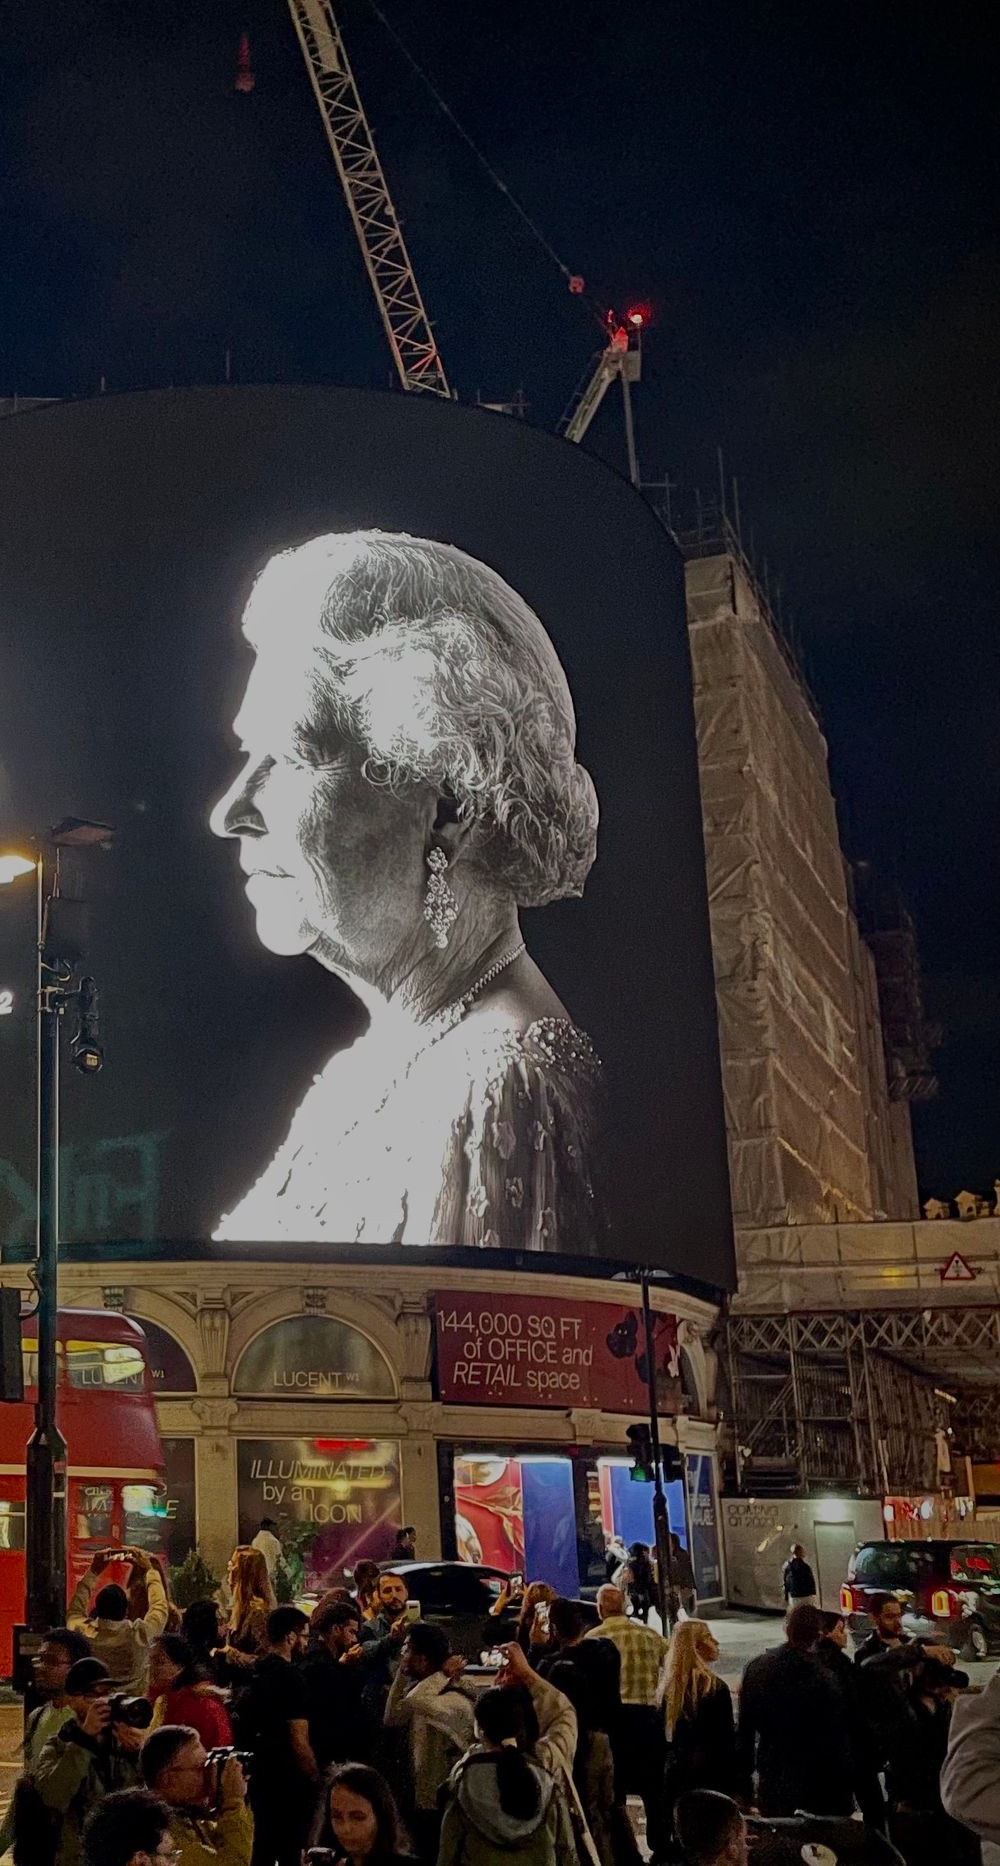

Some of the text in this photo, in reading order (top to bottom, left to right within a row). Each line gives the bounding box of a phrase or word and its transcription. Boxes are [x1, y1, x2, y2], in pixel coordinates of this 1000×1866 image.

[437, 1310, 582, 1340] 144,000 SQ FT
[463, 1338, 593, 1366] of OFFICE and
[273, 1371, 342, 1388] LUCENT
[453, 1361, 581, 1392] RETAIL space
[250, 1459, 386, 1480] ILLUMINATED
[263, 1481, 315, 1505] by an
[310, 1503, 363, 1523] ICON
